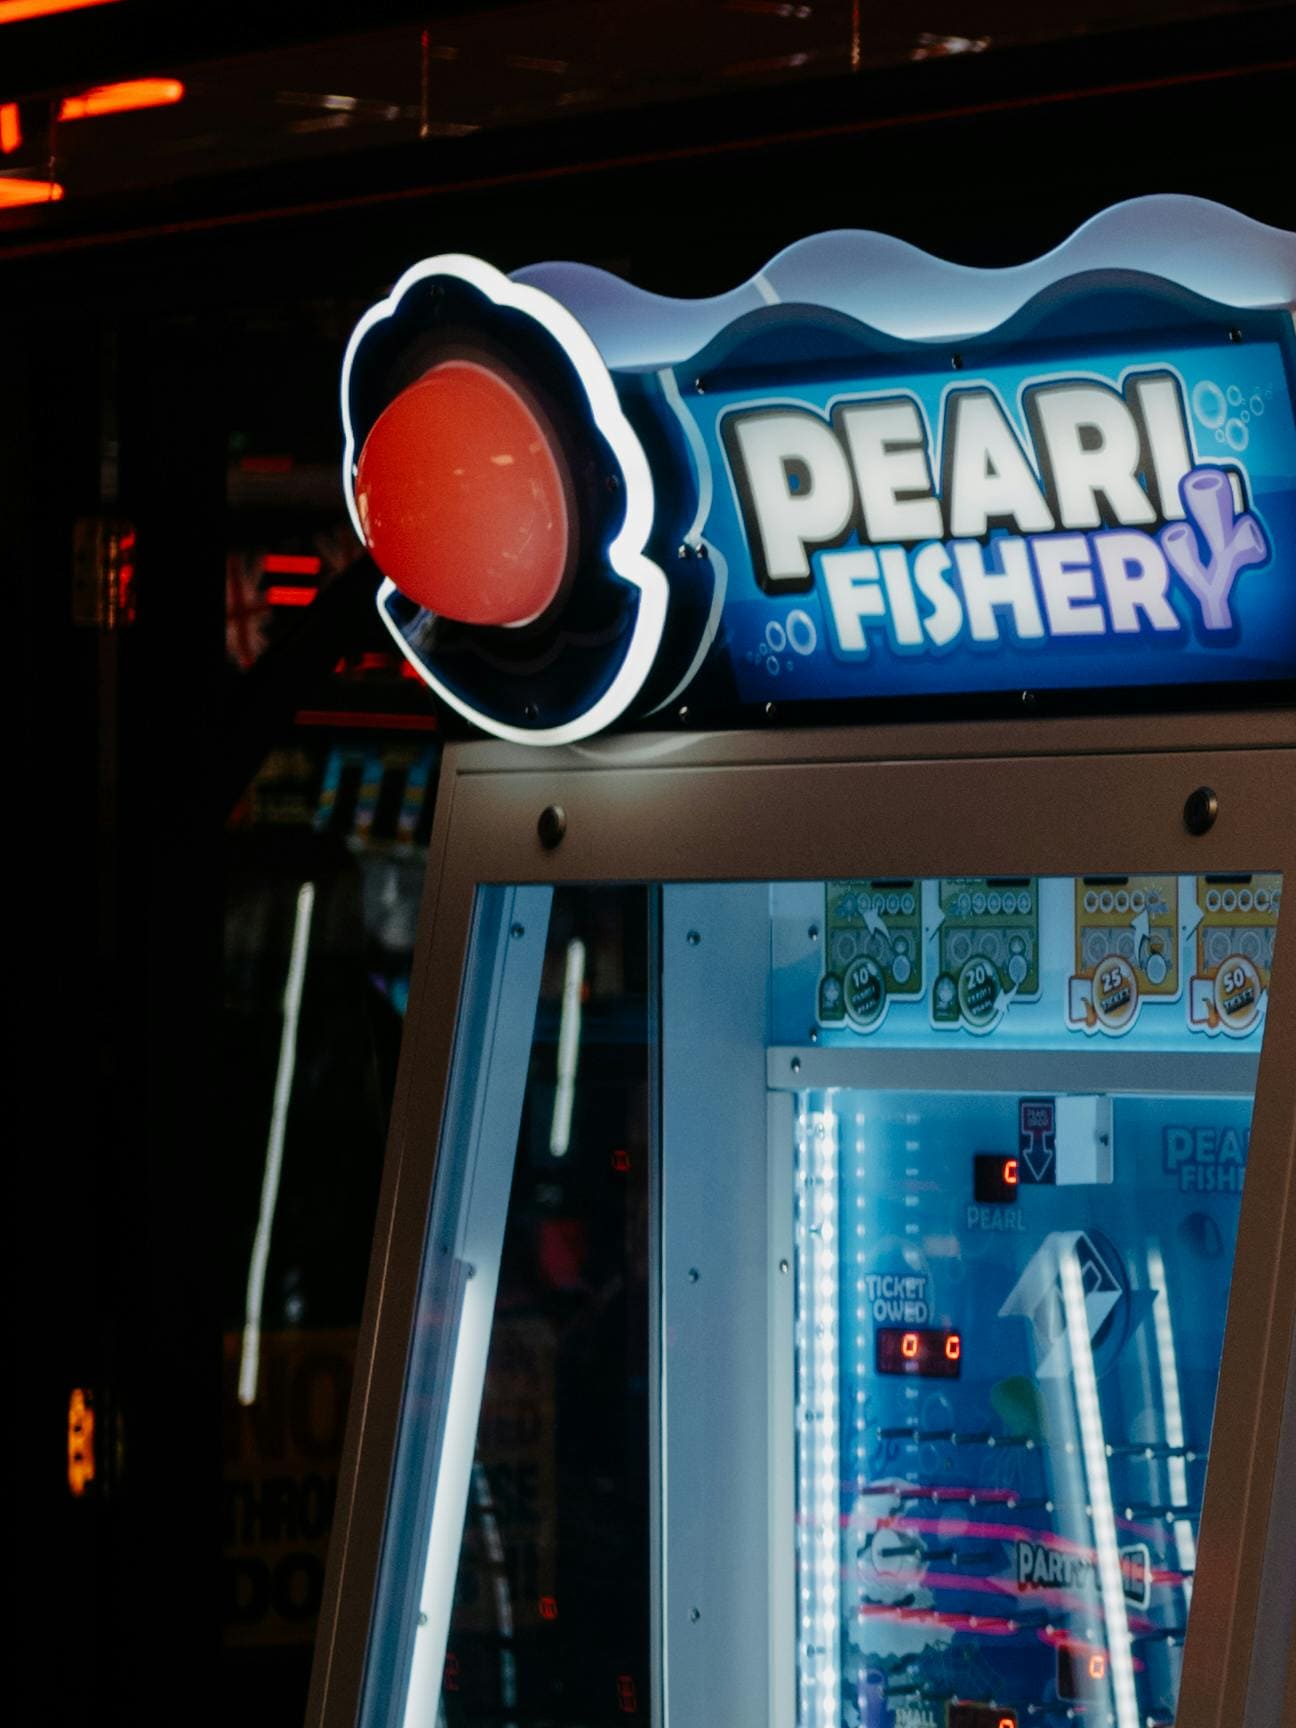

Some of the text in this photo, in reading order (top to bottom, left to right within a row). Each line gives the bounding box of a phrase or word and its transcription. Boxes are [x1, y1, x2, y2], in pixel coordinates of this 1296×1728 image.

[728, 370, 1242, 587] PEARL
[820, 470, 1264, 651] FISHERY
[1101, 968, 1122, 988] 25
[1222, 968, 1245, 989] 50
[967, 1207, 1026, 1230] PEARL
[864, 1275, 927, 1302] TICKET
[873, 1298, 929, 1325] OWED
